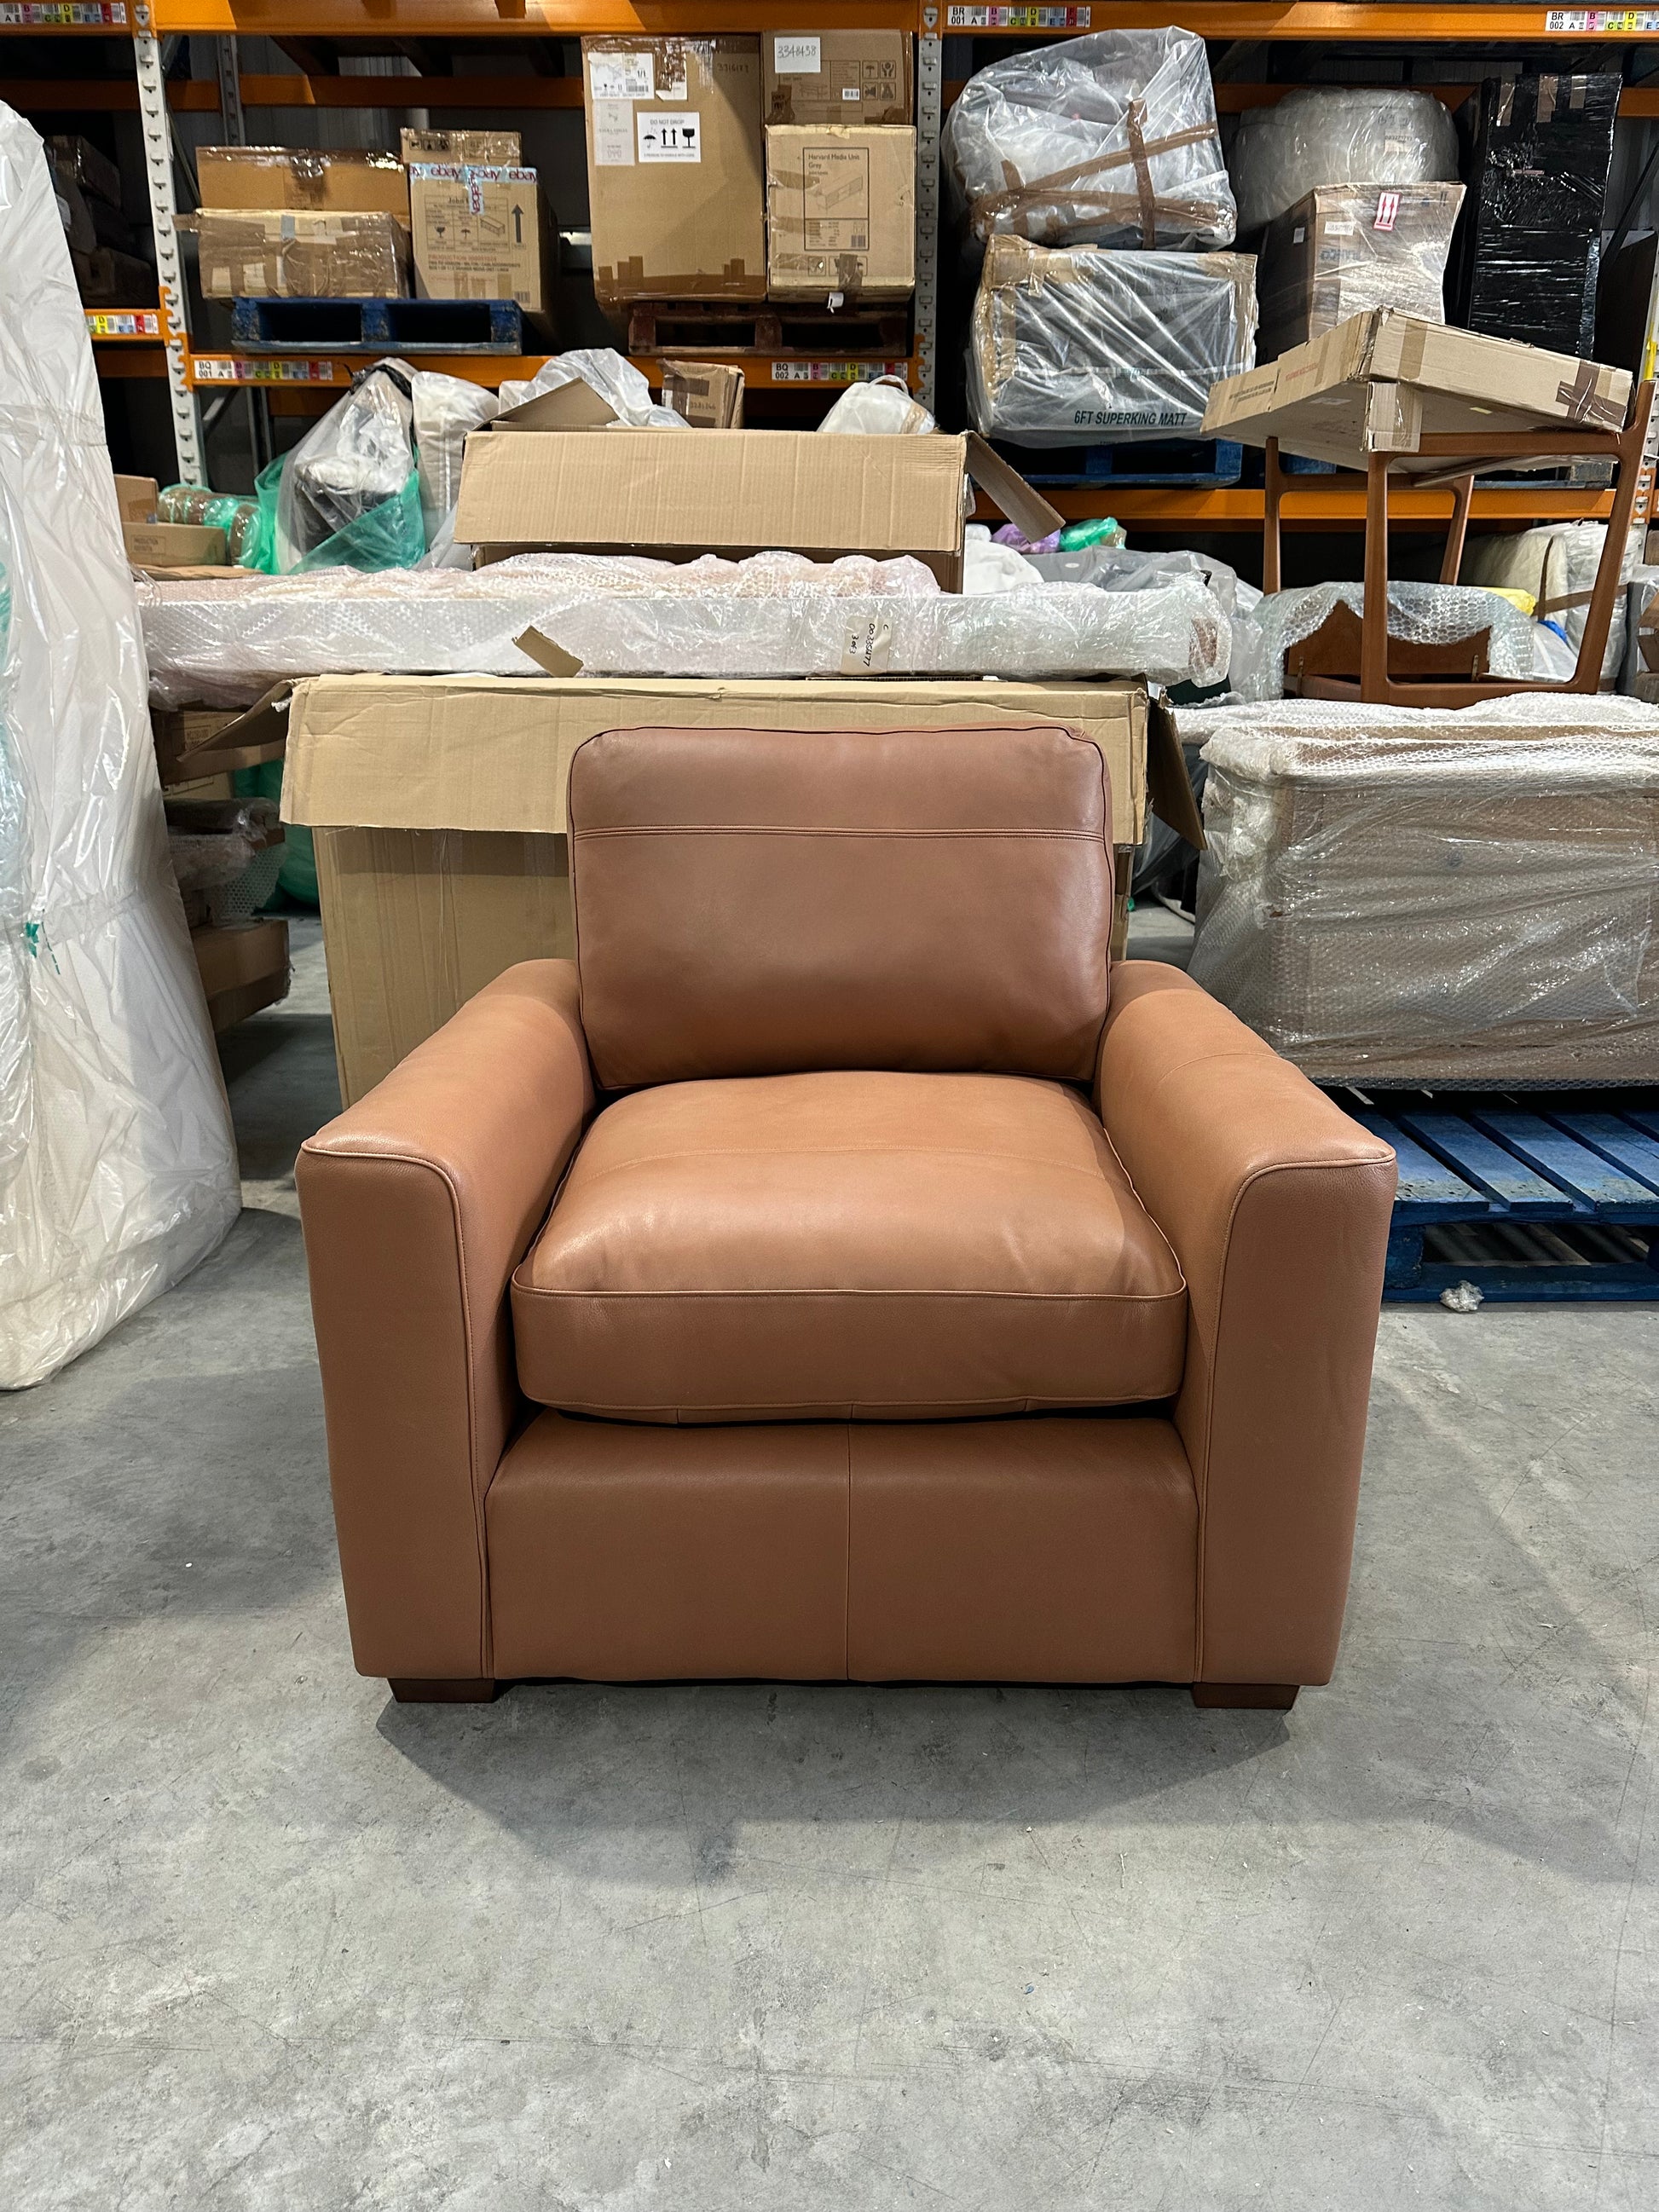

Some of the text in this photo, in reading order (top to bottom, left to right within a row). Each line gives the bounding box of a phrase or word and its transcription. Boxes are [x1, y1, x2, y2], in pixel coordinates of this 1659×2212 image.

[952, 7, 965, 15] BR
[951, 16, 965, 25] 001
[1552, 12, 1564, 20] BR
[431, 165, 460, 179] ebay
[508, 168, 536, 182] ebay
[1074, 410, 1187, 426] 6FT SUPERKING MATT
